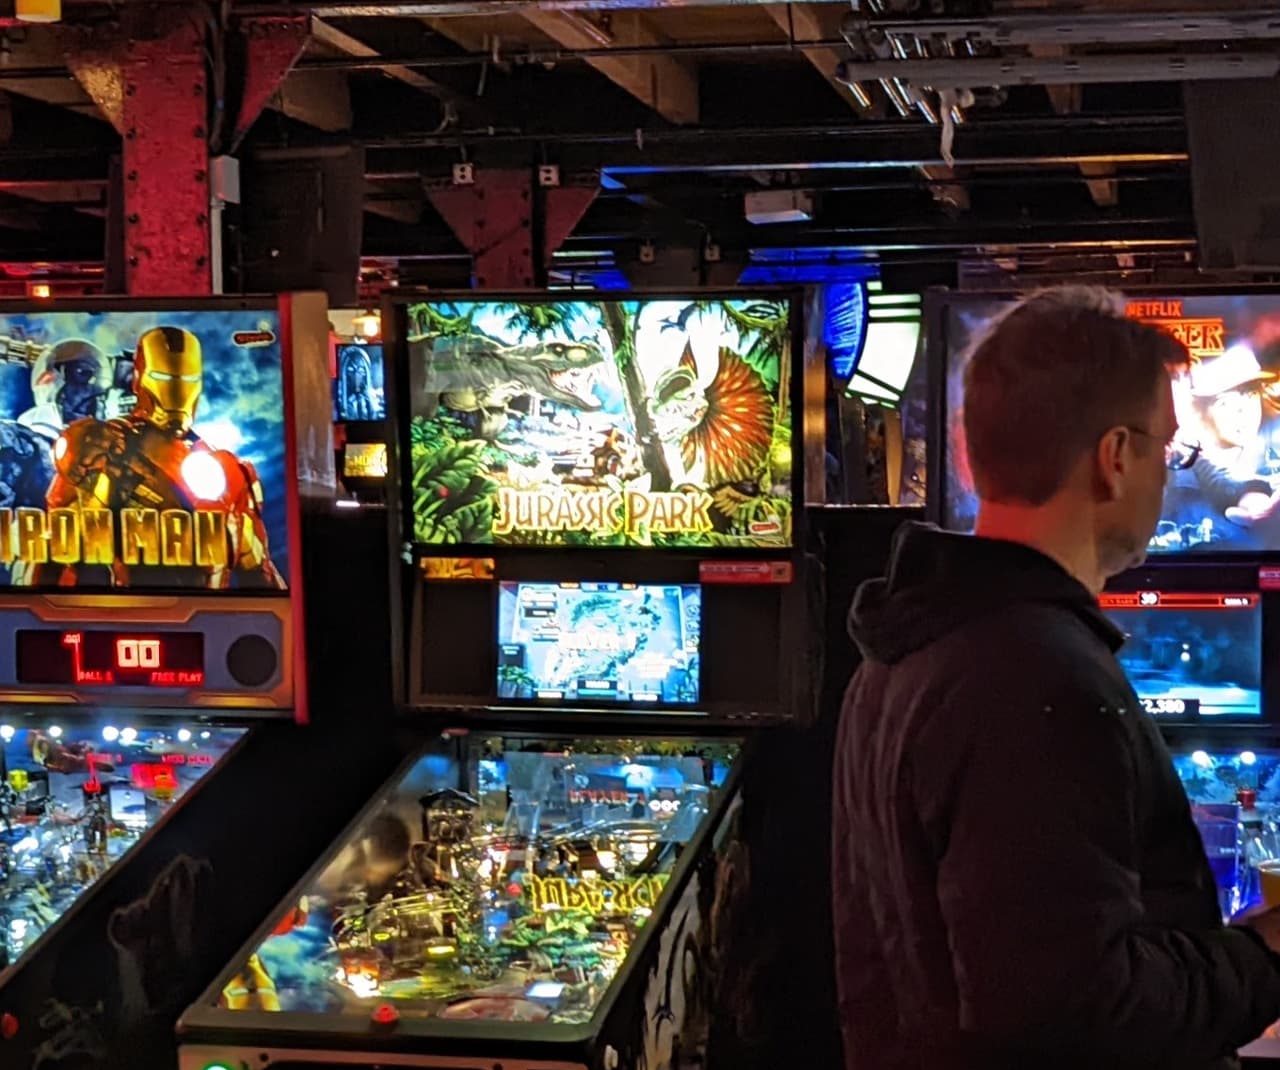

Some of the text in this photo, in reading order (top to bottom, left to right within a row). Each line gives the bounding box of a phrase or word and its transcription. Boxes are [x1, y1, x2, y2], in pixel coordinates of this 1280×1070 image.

[120, 508, 228, 566] MAN
[493, 488, 713, 535] JURASSIC PARK
